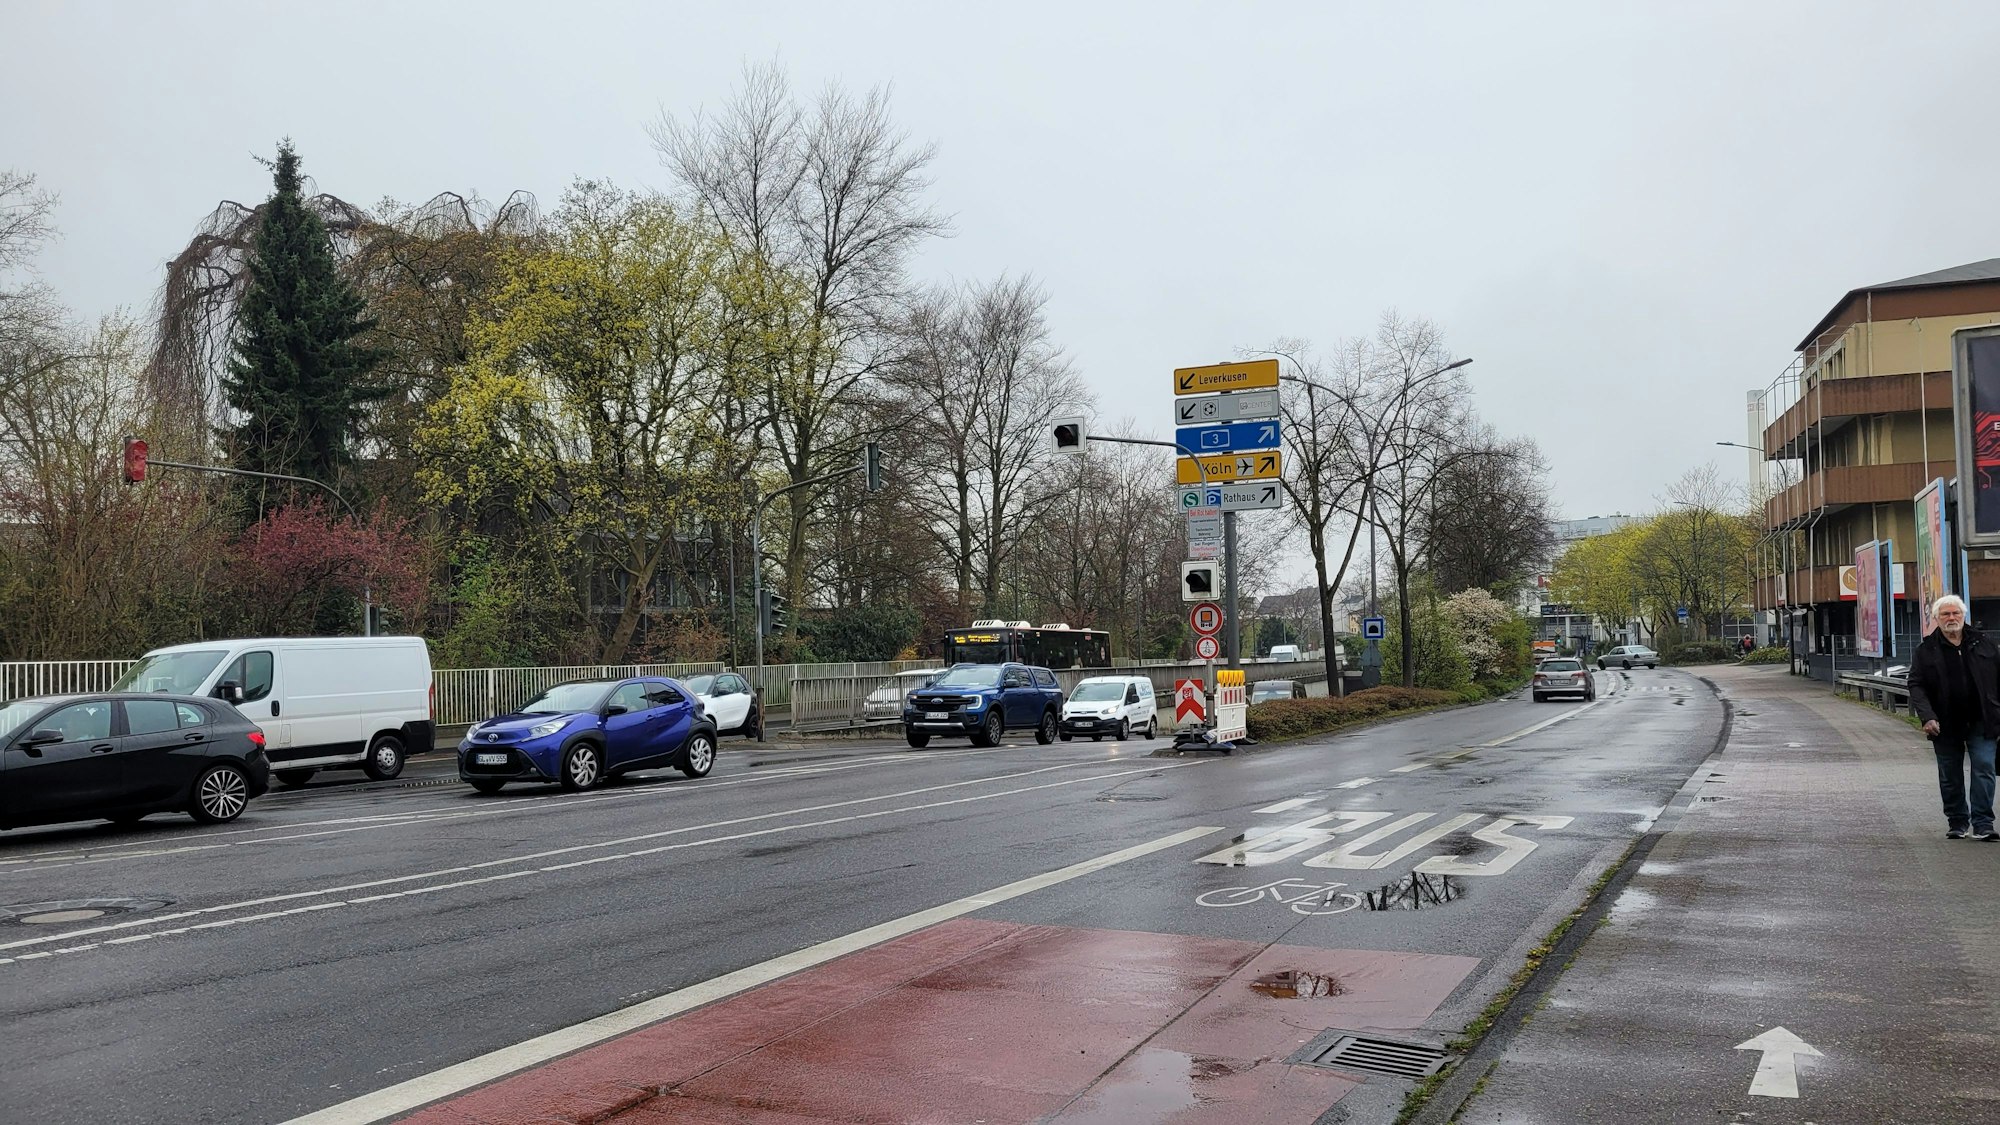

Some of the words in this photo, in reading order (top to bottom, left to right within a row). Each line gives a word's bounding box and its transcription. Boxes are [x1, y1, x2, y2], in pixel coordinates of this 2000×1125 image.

[1199, 372, 1247, 385] Leverkusen
[1212, 434, 1219, 445] 3
[1202, 462, 1232, 476] Köln
[1223, 492, 1256, 503] Rathaus
[1192, 811, 1574, 876] BUS
